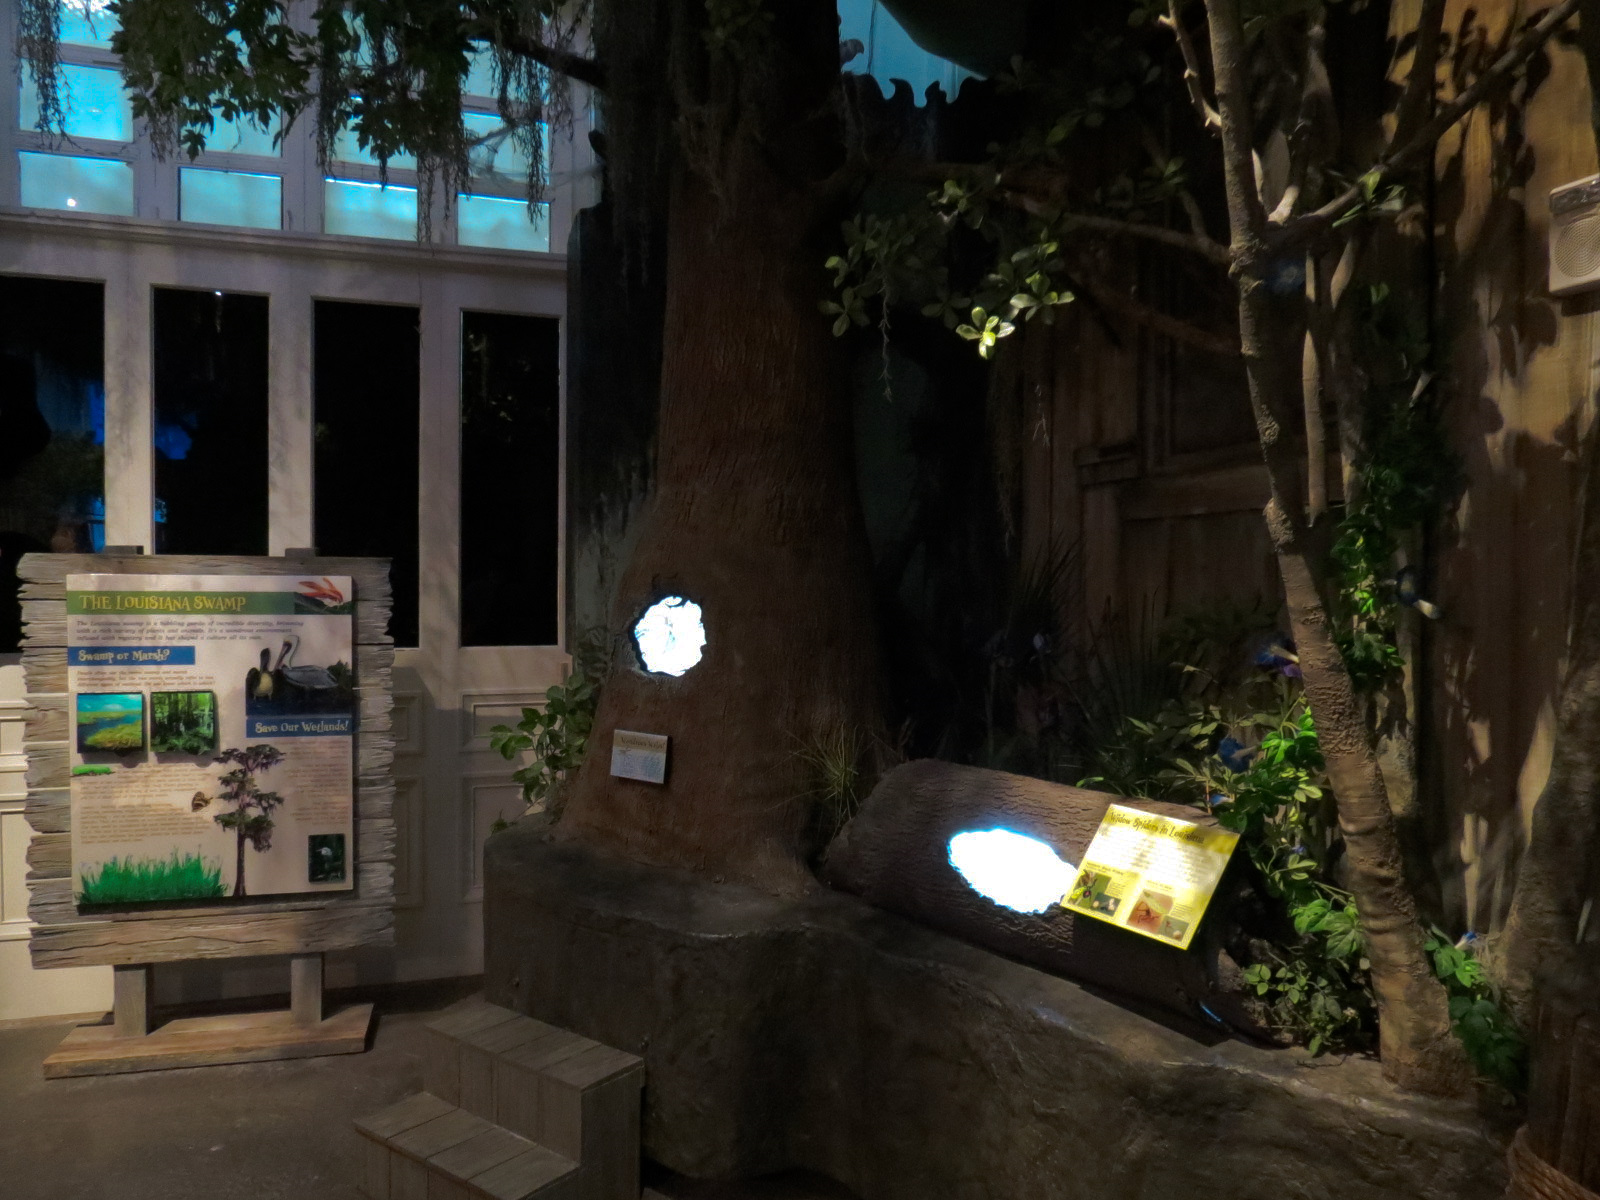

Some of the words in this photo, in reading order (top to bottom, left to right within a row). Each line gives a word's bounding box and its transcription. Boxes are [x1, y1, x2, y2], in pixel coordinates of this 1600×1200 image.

[79, 595, 112, 610] THE
[116, 595, 191, 611] LOUISIANA
[193, 595, 247, 611] SWAMP
[78, 649, 115, 664] Swamp
[116, 652, 130, 660] or
[131, 648, 170, 662] Marsh?
[255, 722, 278, 733] Save
[280, 722, 299, 732] Our
[301, 720, 349, 733] Wetlands!
